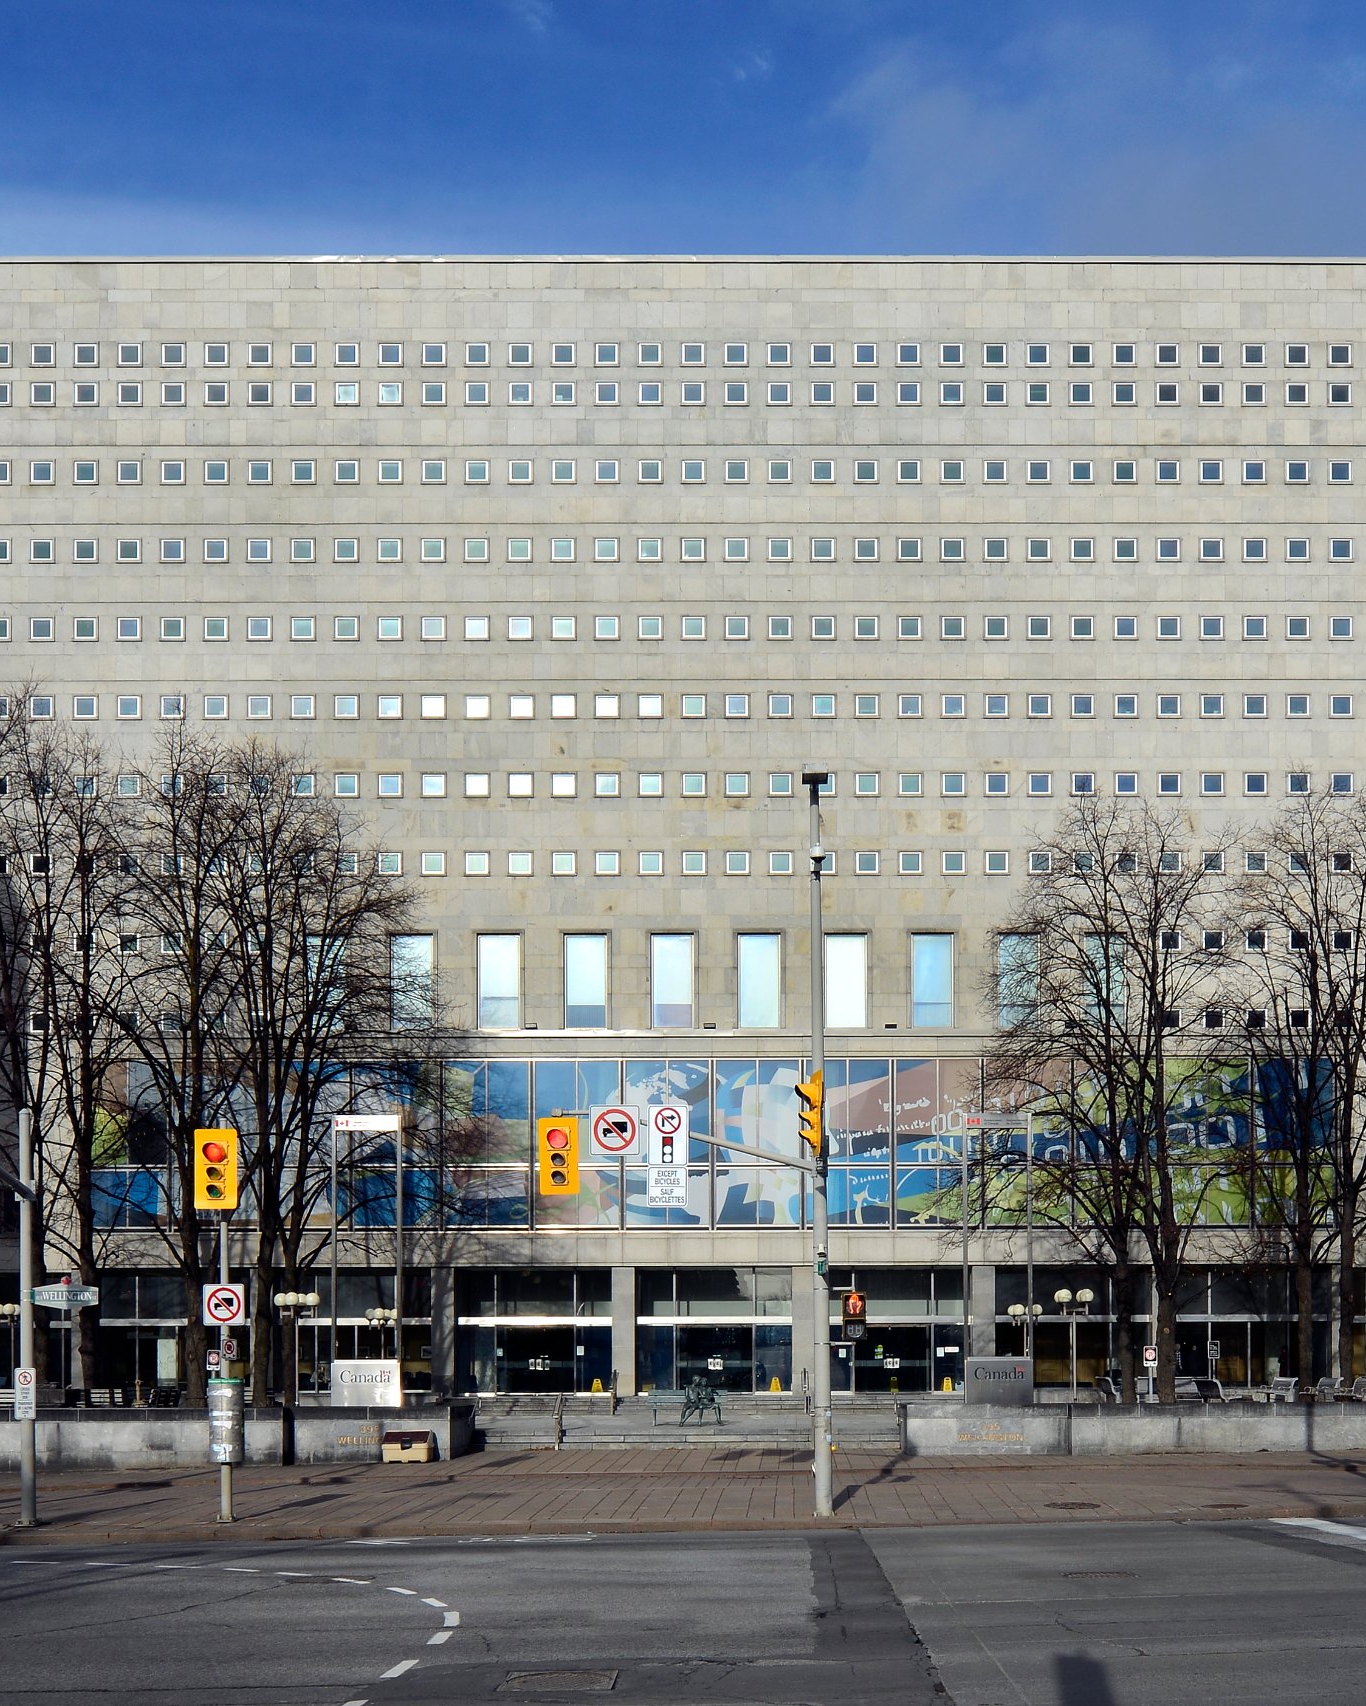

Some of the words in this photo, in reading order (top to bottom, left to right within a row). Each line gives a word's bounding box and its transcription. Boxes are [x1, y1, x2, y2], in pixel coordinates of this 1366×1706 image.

[657, 1170, 678, 1178] EXCEPT
[660, 1188, 675, 1196] SAUF
[649, 1196, 685, 1204] BICYCLETTES
[42, 1291, 92, 1301] WELLINGTON
[340, 1370, 390, 1383] Canada
[974, 1366, 1024, 1380] Canada
